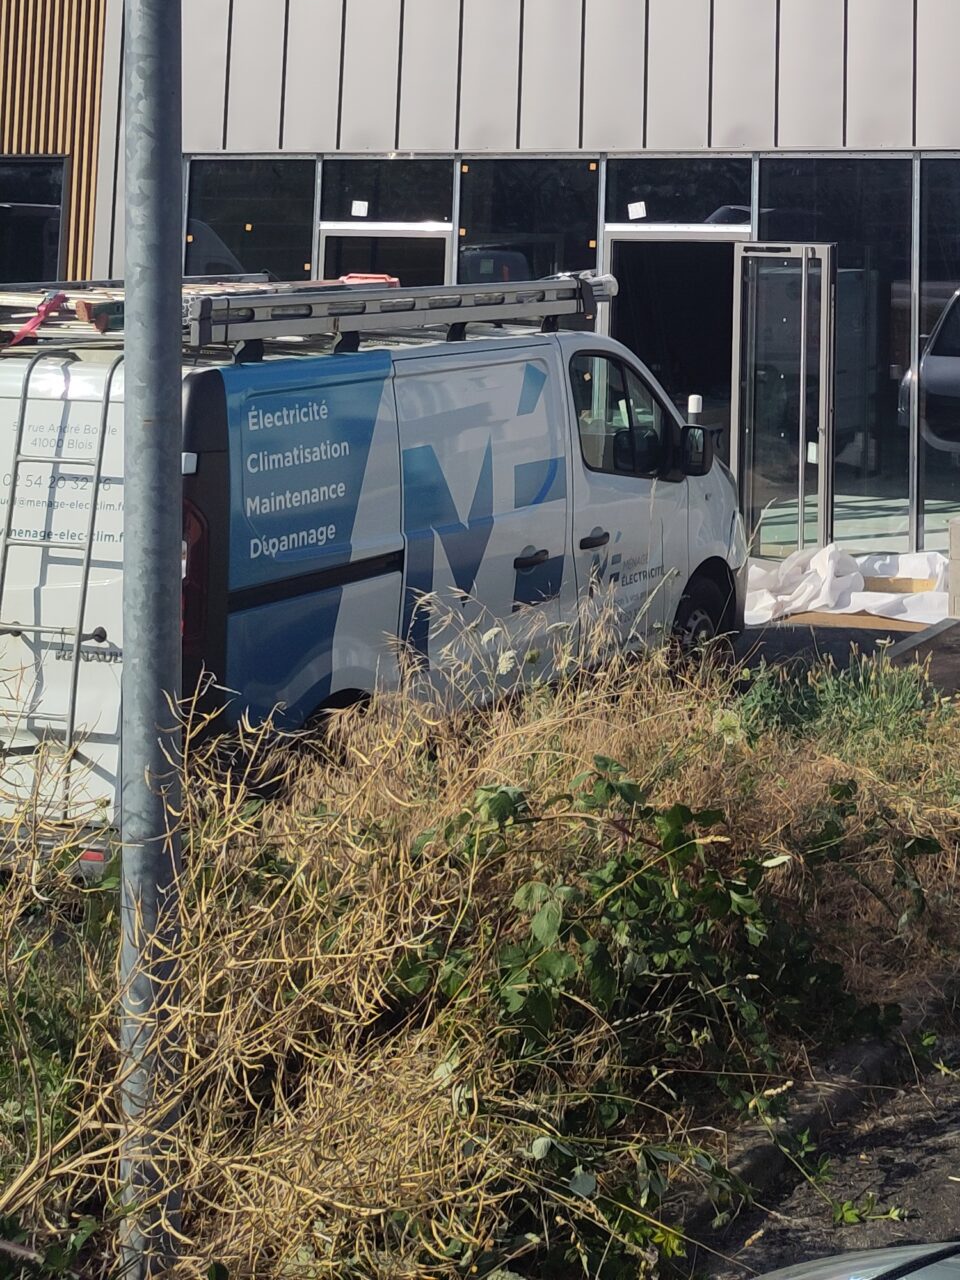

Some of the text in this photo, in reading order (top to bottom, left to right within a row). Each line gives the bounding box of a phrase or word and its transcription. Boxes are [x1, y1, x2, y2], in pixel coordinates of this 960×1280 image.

[248, 400, 328, 431] Électricité
[28, 423, 45, 433] rue
[48, 423, 80, 434] André
[83, 424, 118, 436] Bole
[30, 437, 93, 450] 41000 Blois
[247, 440, 350, 474] Climatisation
[25, 475, 43, 488] 54
[48, 476, 66, 489] 20
[70, 477, 89, 490] 32
[246, 482, 346, 517] Maintenance
[250, 524, 336, 558] Dépannage
[55, 650, 123, 663] RENAUL
